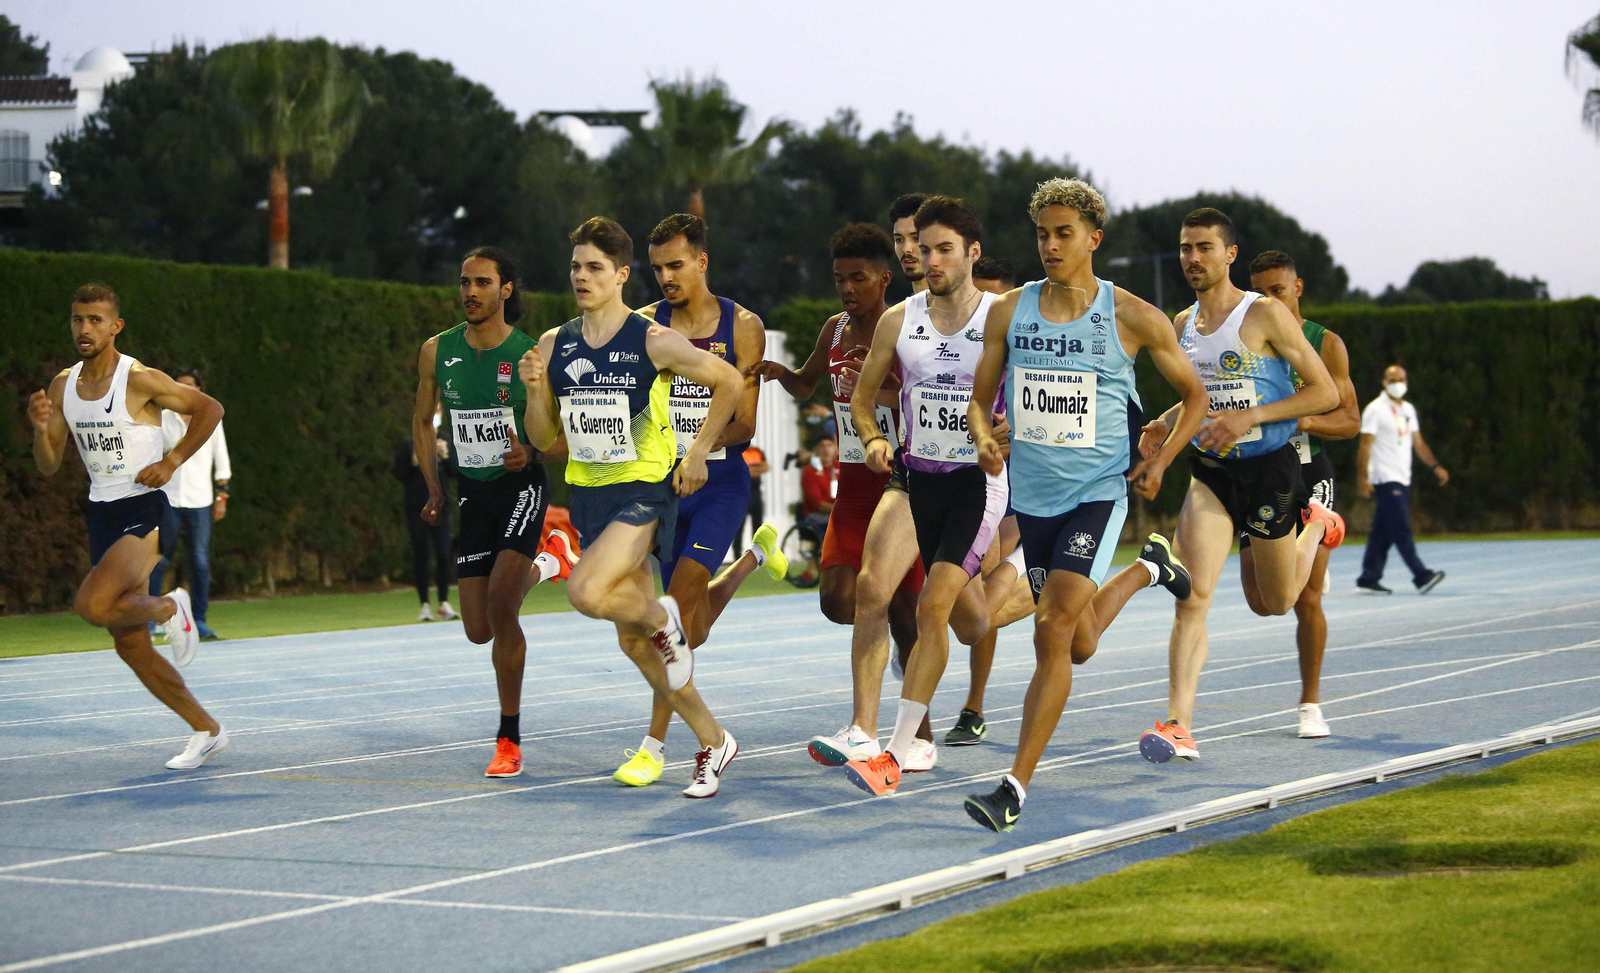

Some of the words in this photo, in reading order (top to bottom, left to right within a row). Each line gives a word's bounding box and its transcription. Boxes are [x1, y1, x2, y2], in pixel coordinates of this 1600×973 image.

[1014, 334, 1084, 357] nerja
[620, 352, 640, 360] Jaén
[1022, 356, 1074, 366] ATLETISMO
[594, 372, 637, 387] Unicaja
[1024, 372, 1055, 382] DESAFÍO
[1058, 376, 1083, 384] NERJA
[674, 385, 711, 398] BARÇA
[921, 392, 948, 402] DESAFÍO
[570, 398, 595, 406] DESAFÍO
[1022, 386, 1034, 410] O.
[1038, 388, 1088, 414] Oumaiz
[458, 410, 482, 420] DESAFÍO
[482, 410, 503, 419] NERJA
[920, 404, 932, 429] C.
[938, 407, 969, 432] Sáe
[569, 412, 579, 434] A.
[580, 412, 624, 434] Guerrero
[1076, 416, 1082, 428] 1
[457, 423, 472, 444] M.
[474, 420, 509, 444] Katir
[611, 434, 627, 446] 12
[116, 451, 123, 460] 3
